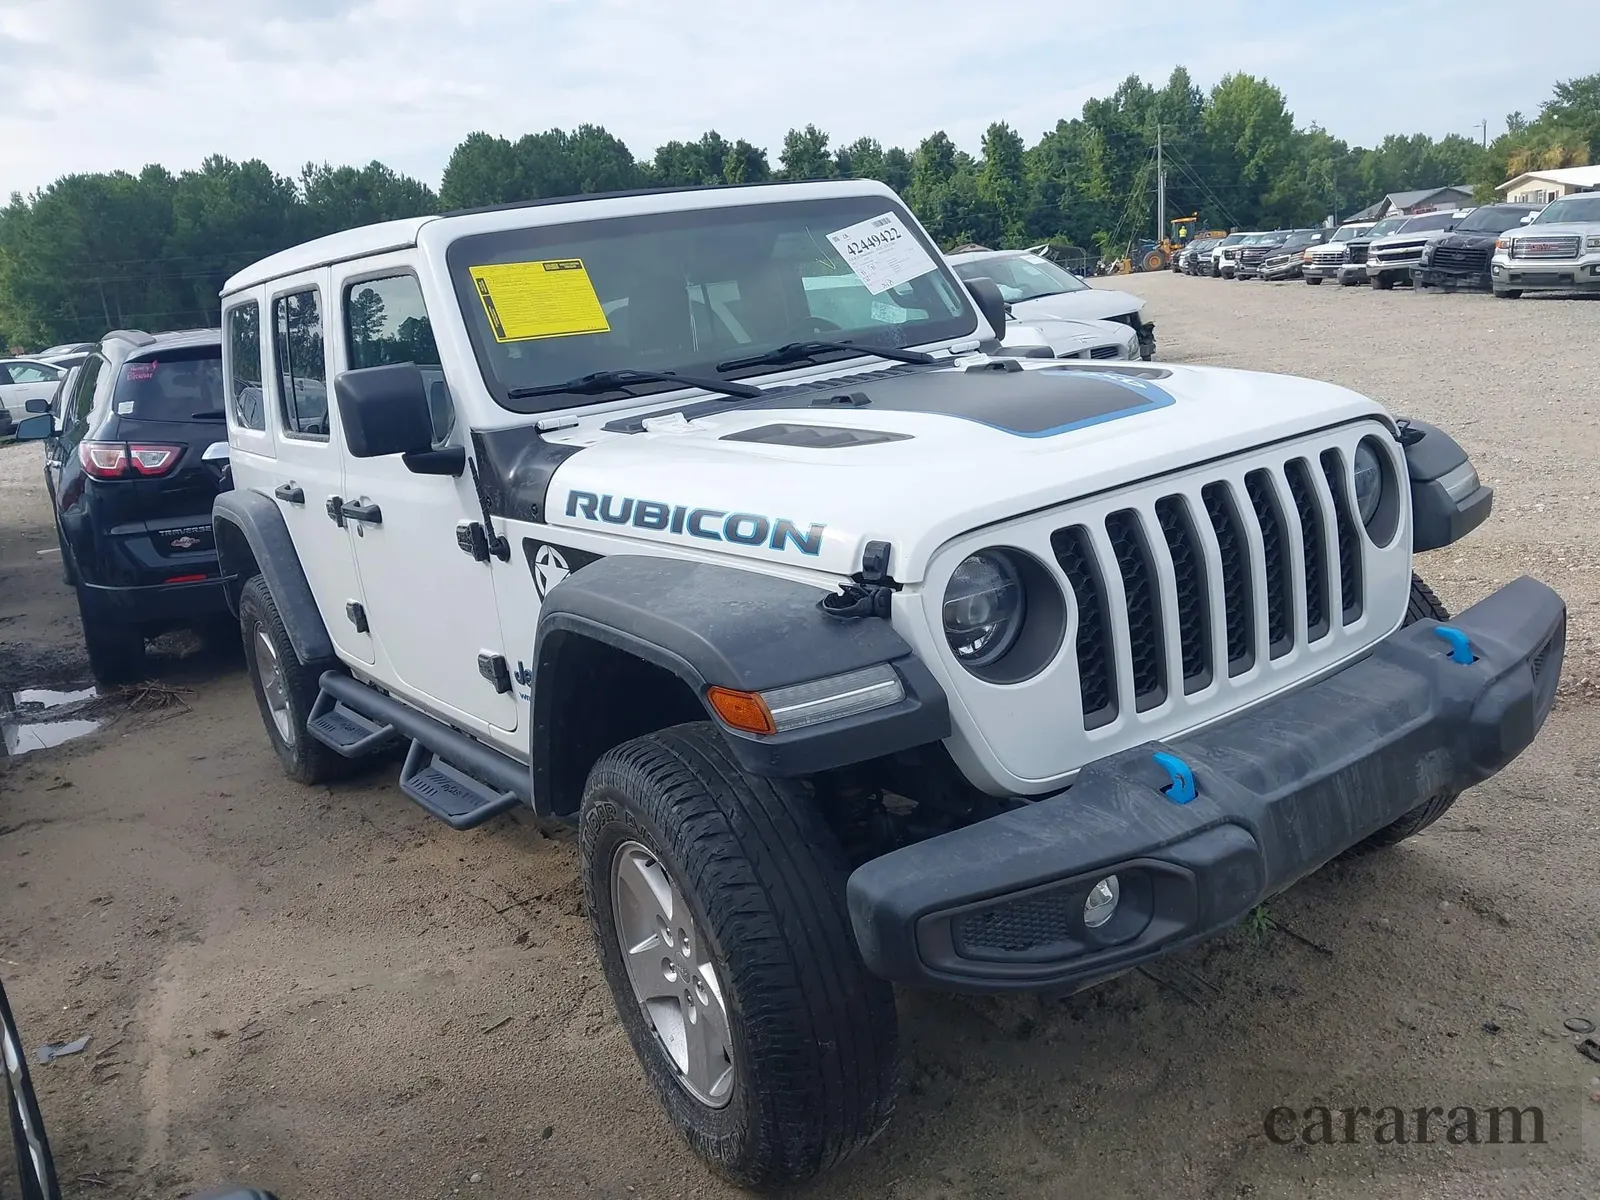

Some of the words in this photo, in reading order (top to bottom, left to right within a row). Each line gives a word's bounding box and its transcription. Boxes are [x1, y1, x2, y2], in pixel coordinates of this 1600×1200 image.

[847, 228, 902, 256] 42449422
[158, 525, 212, 537] TRAVERSE
[565, 489, 828, 557] RUBICON
[514, 659, 532, 688] Je
